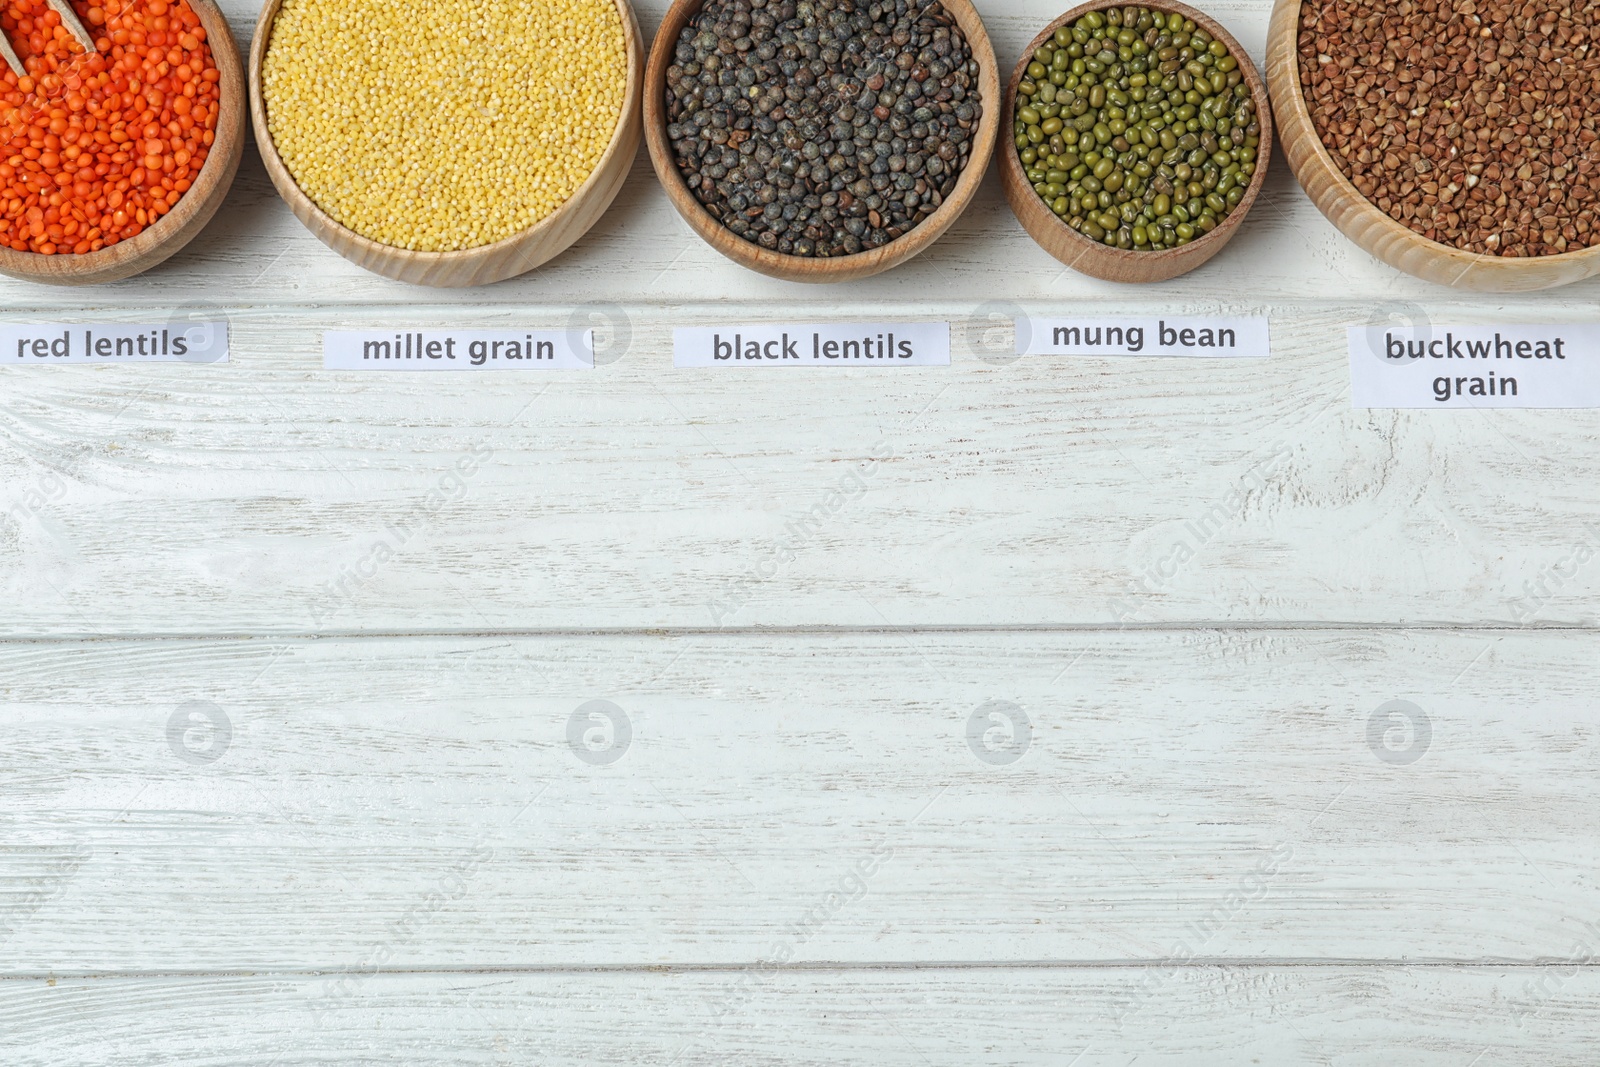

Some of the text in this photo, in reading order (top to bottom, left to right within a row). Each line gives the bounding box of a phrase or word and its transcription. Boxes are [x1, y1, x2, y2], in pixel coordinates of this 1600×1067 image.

[17, 329, 188, 358] red lentils
[363, 333, 554, 366] millet grain
[713, 332, 913, 360] black lentils
[1053, 320, 1236, 352] mung bean
[1386, 332, 1566, 360] buckwheat
[1432, 371, 1518, 402] grain
